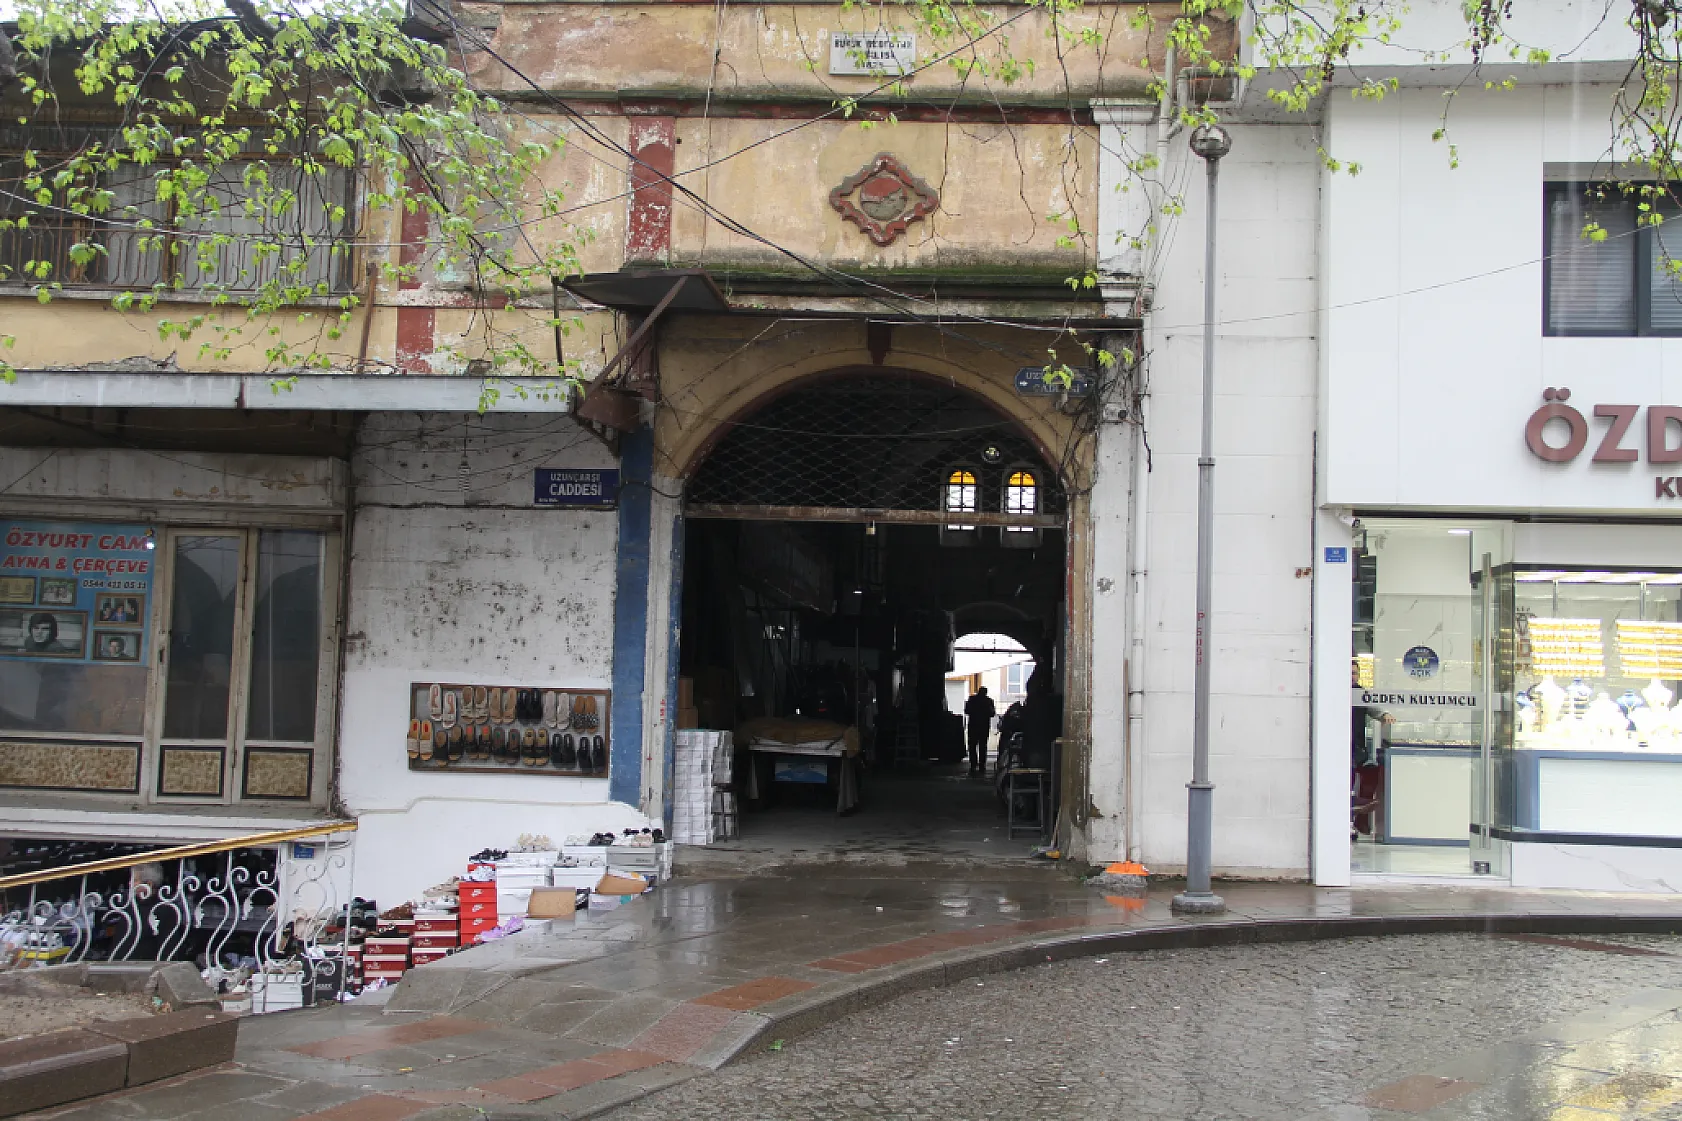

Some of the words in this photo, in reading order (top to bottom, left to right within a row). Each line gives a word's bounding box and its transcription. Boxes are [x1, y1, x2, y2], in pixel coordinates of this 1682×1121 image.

[1525, 386, 1682, 464] ÖZD
[550, 472, 601, 483] UZUNÇARŞI
[549, 482, 603, 496] CADDESİ
[6, 527, 94, 549] ÖZYURT
[2, 555, 51, 570] AYNA
[55, 557, 67, 571] &
[73, 558, 149, 576] ÇERÇEVE
[1410, 669, 1431, 678] AÇIK
[1362, 690, 1405, 704] ÖZDEN
[1410, 694, 1477, 707] KUYUMCU
